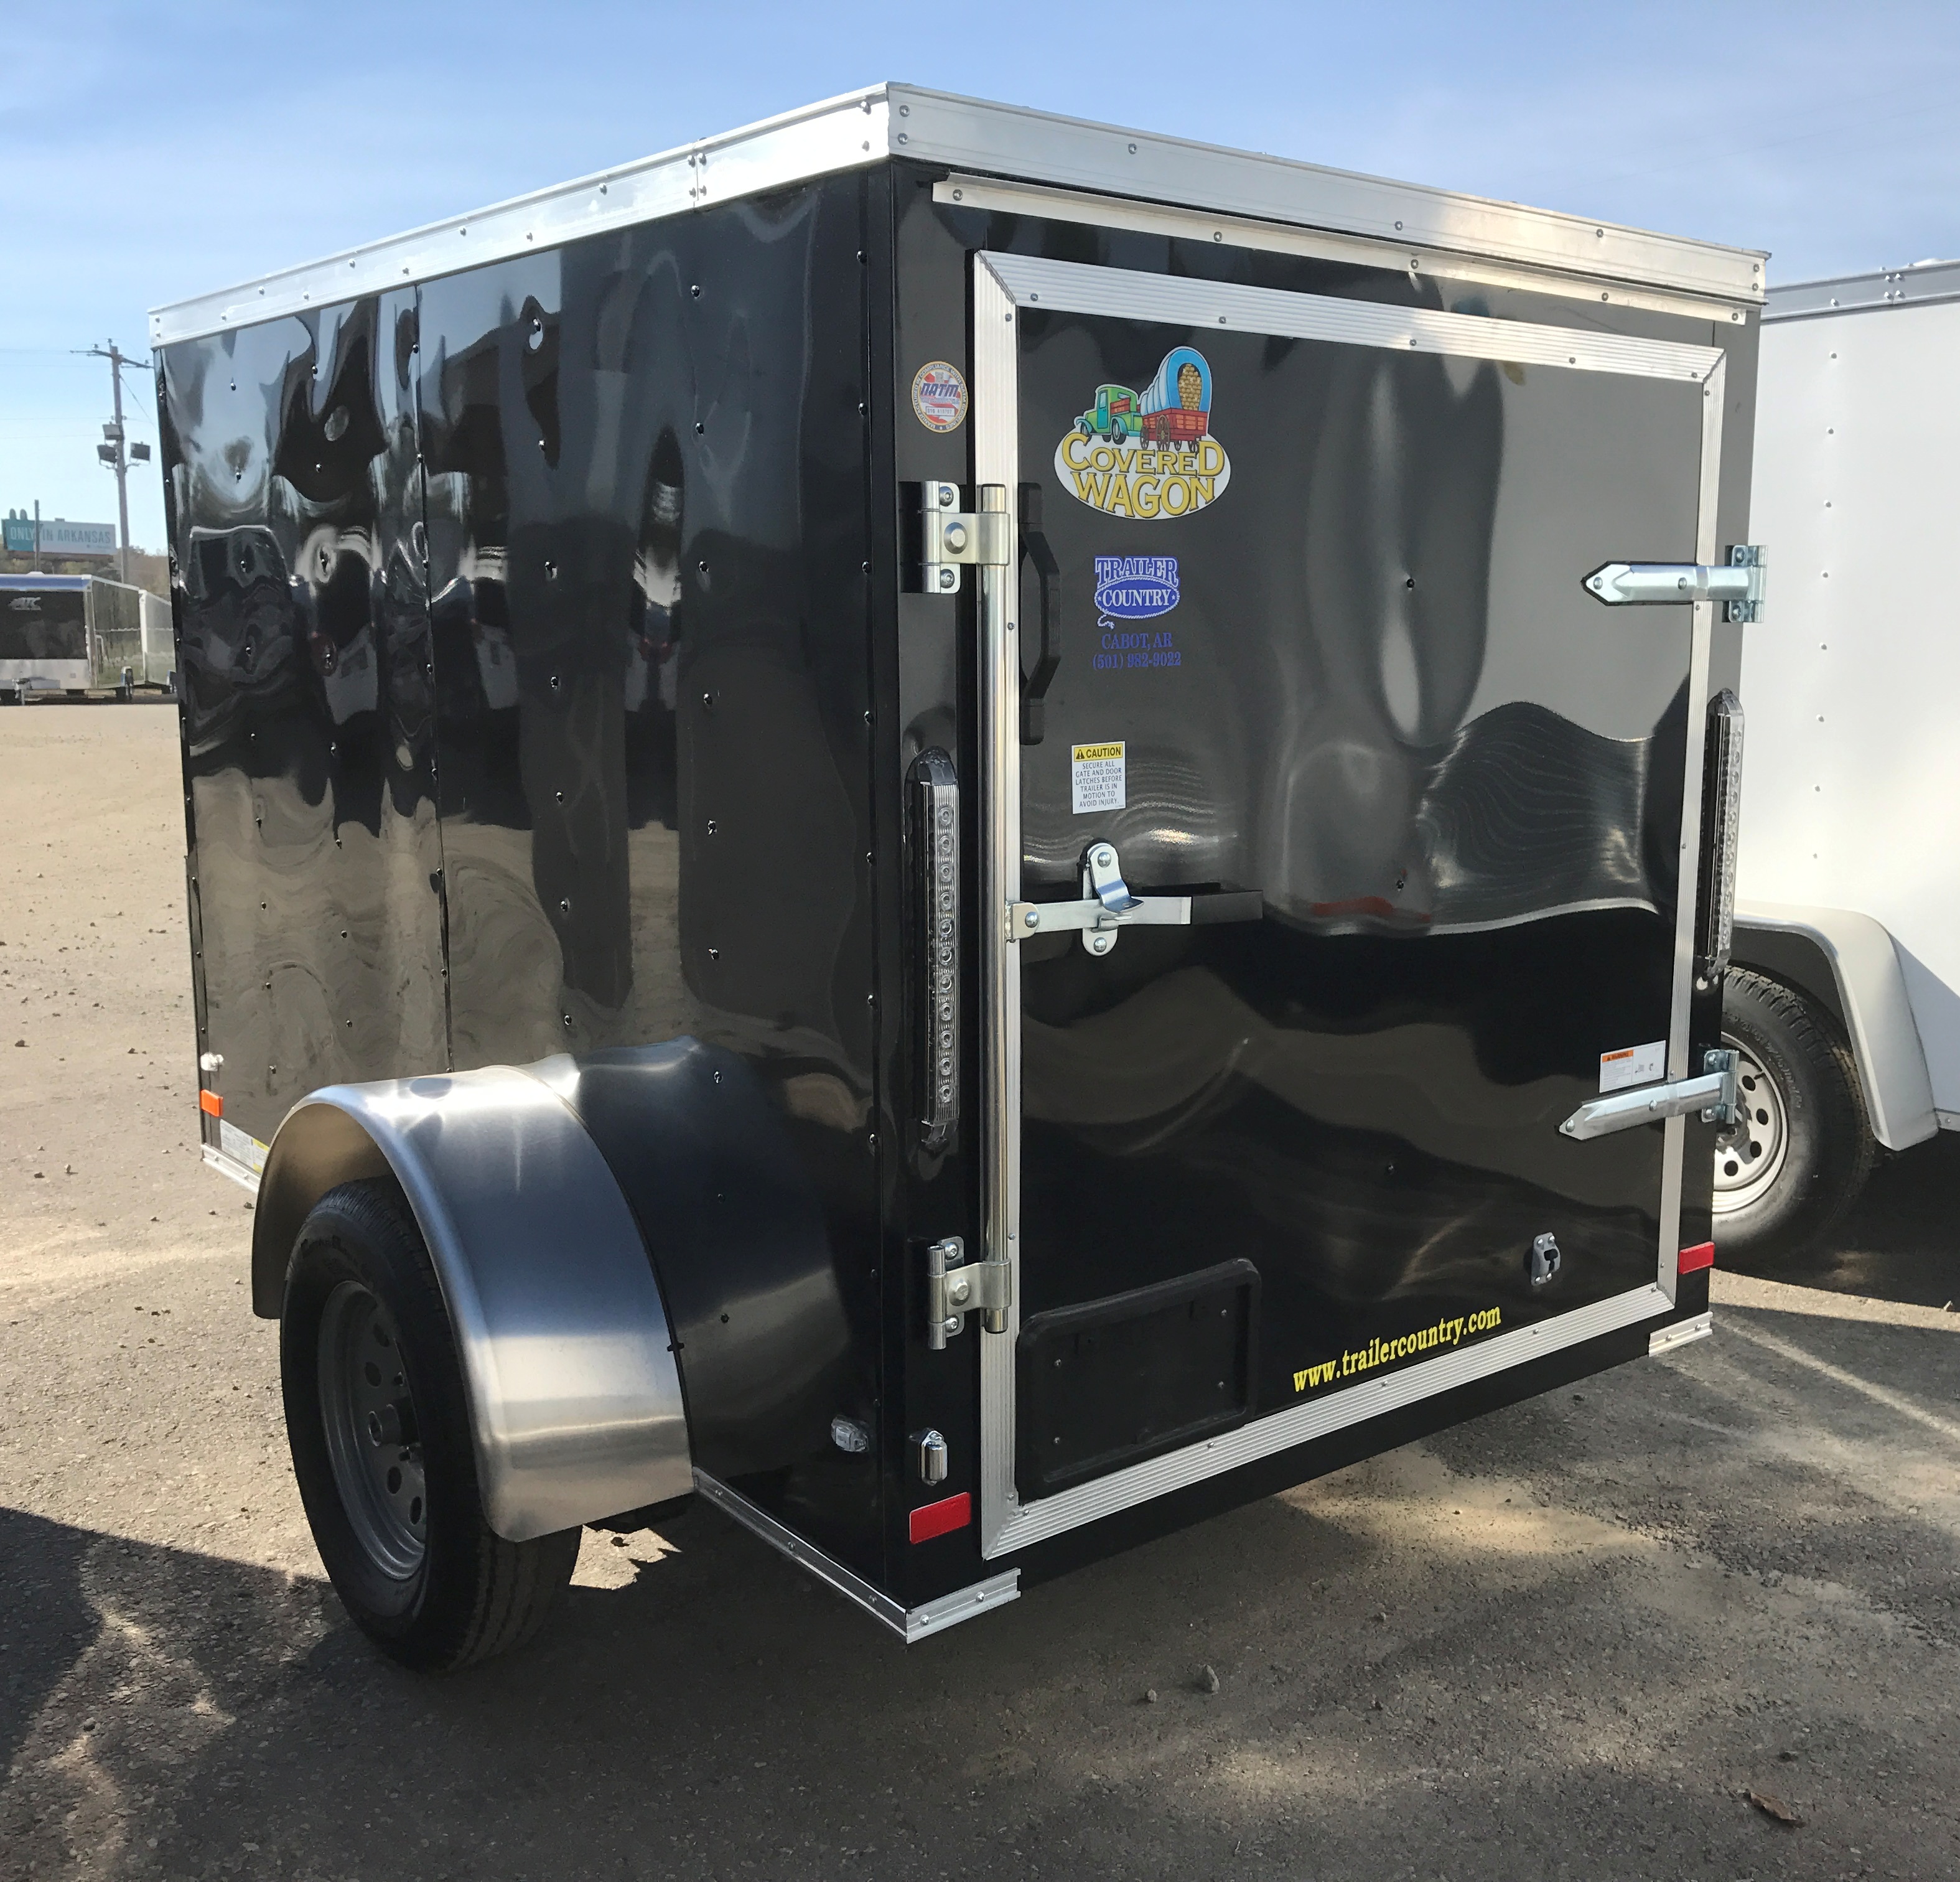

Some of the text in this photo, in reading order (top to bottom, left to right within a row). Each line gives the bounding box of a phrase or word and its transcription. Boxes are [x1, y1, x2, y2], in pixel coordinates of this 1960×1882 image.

[1062, 432, 1225, 477] COVERED
[1070, 471, 1215, 518] WAGON
[43, 528, 54, 541] IN
[58, 530, 111, 544] ARKANSAS
[1095, 558, 1180, 588] TRAILER
[1102, 589, 1171, 607] COUNTRY
[1101, 632, 1173, 650] CABOT, AR
[1093, 653, 1124, 670] (501)
[1086, 746, 1121, 758] CAUTION
[1075, 777, 1100, 785] LATCHES
[1081, 784, 1103, 792] TRAILER
[1099, 798, 1119, 806] INJURY.
[1293, 1306, 1501, 1392] www.trailercountry.com
